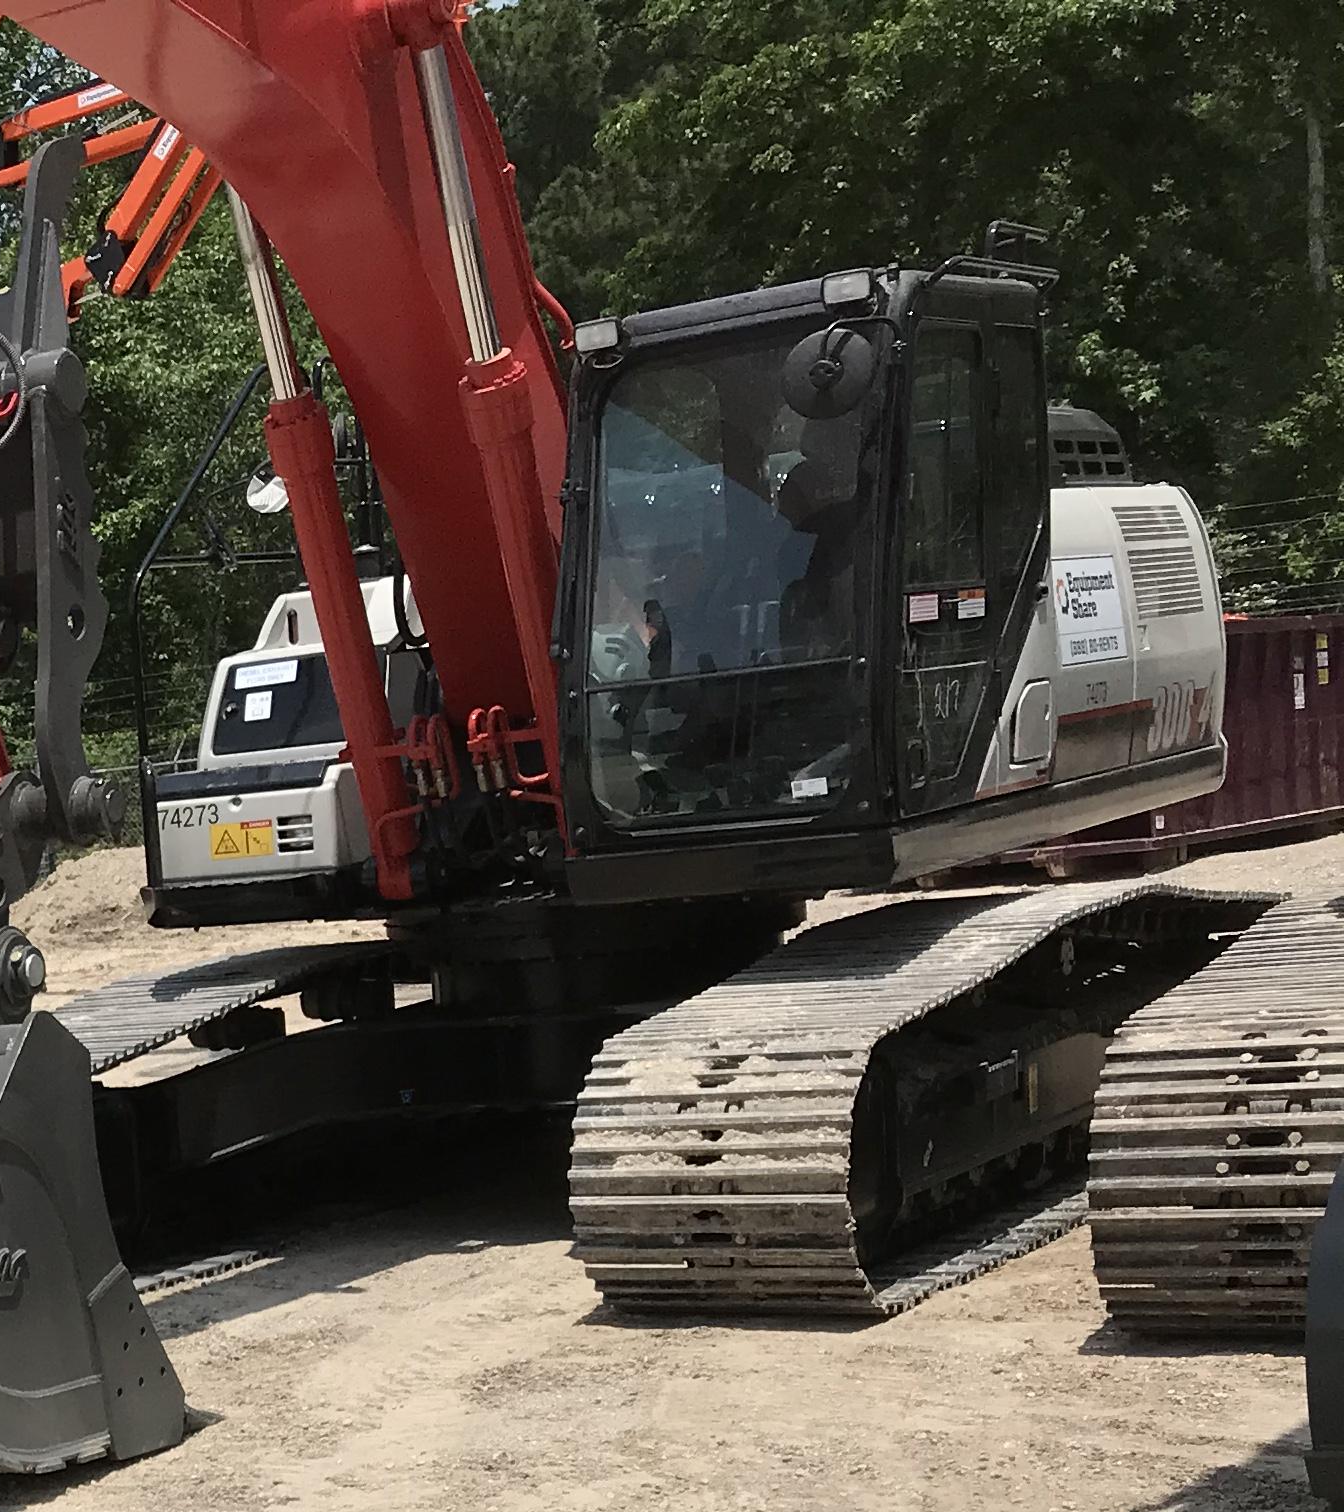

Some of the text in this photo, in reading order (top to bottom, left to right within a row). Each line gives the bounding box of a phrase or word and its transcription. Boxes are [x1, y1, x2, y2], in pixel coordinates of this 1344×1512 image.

[1066, 571, 1115, 598] Equipment
[1071, 597, 1098, 620] Share
[157, 803, 220, 831] 74273
